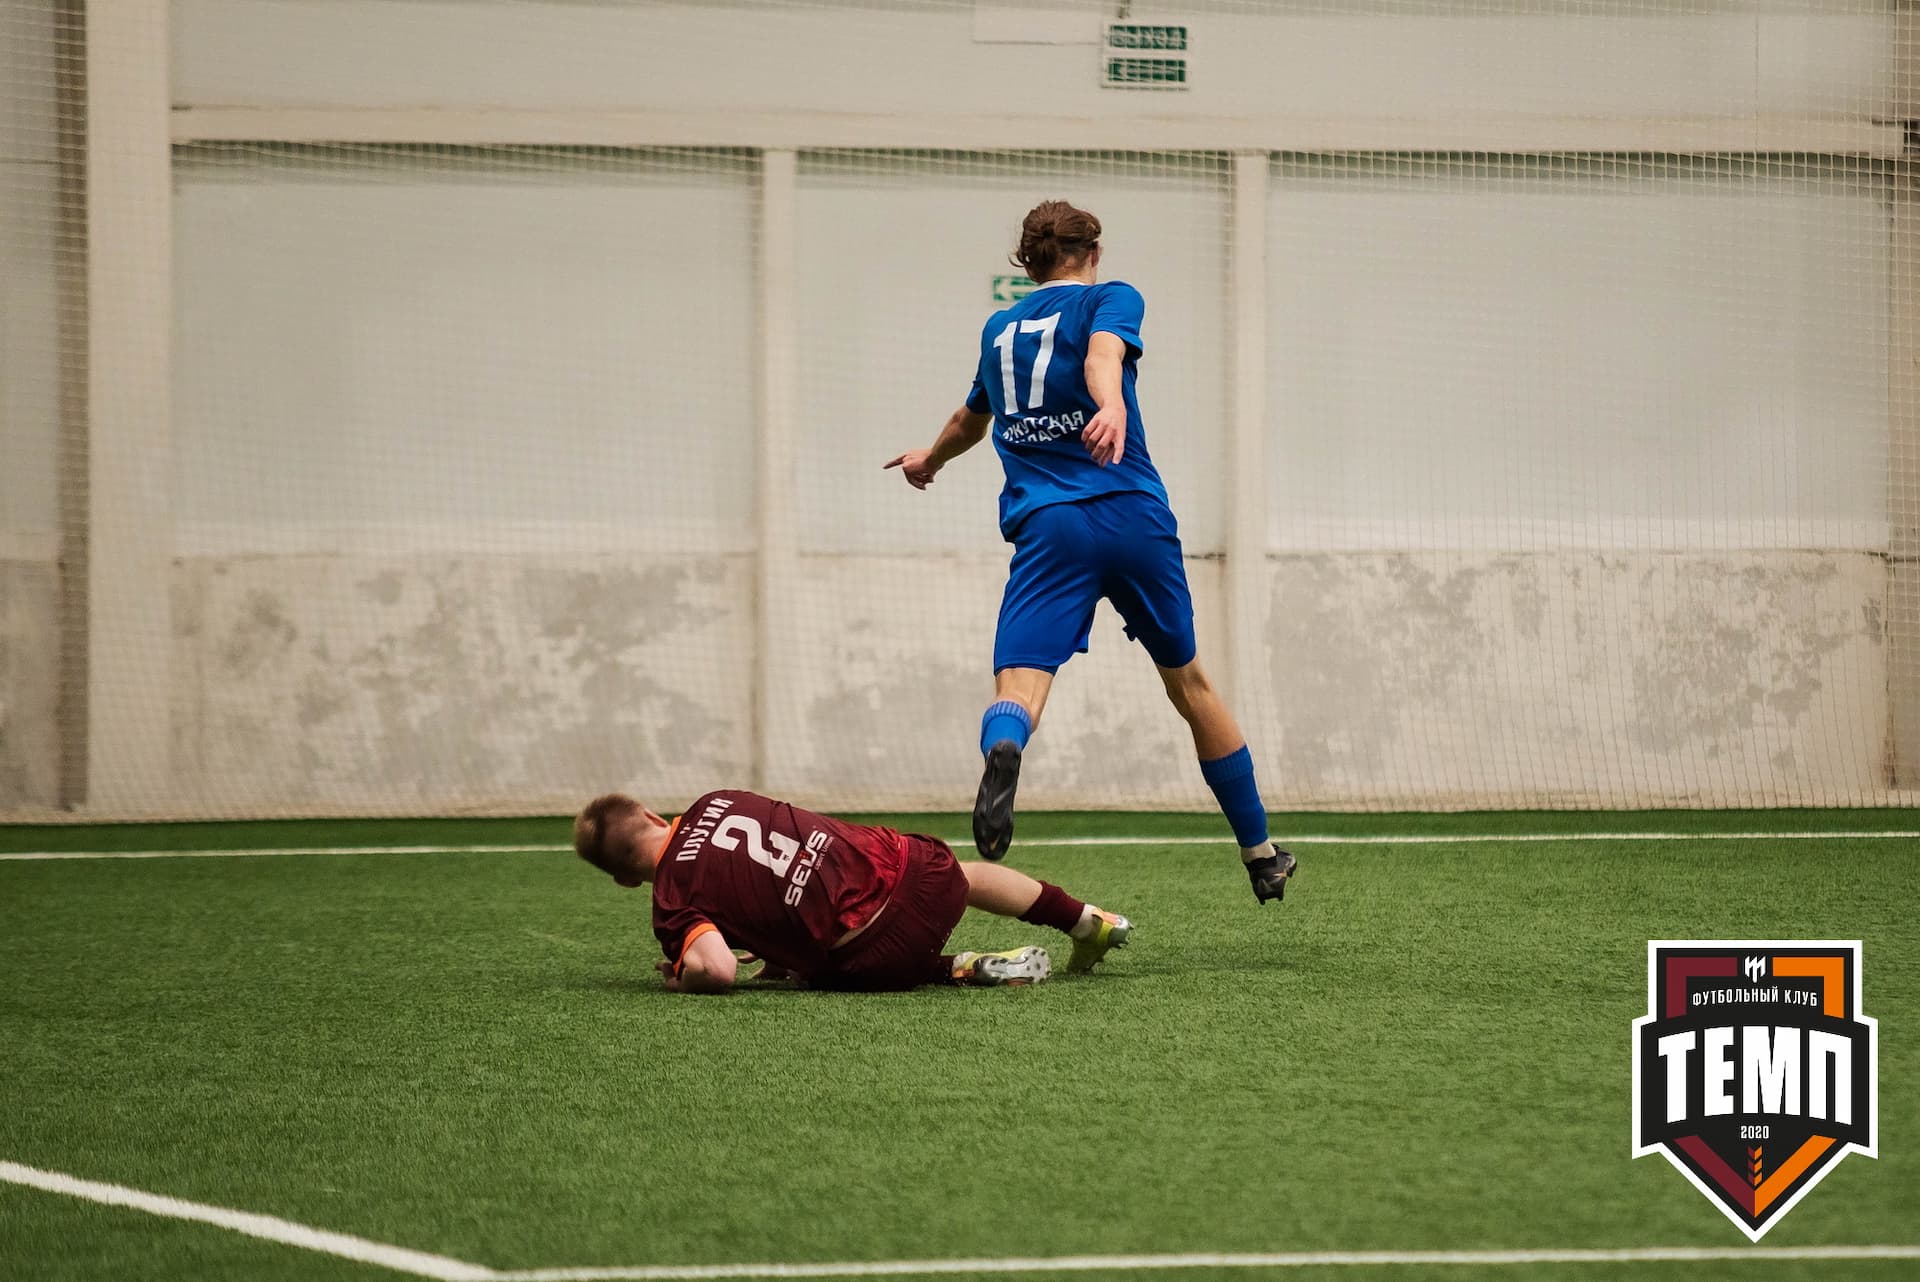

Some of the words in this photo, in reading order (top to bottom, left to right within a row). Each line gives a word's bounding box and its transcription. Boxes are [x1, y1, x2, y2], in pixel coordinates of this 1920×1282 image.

[993, 311, 1062, 416] 17
[711, 814, 801, 879] 2
[784, 829, 828, 907] SEUS
